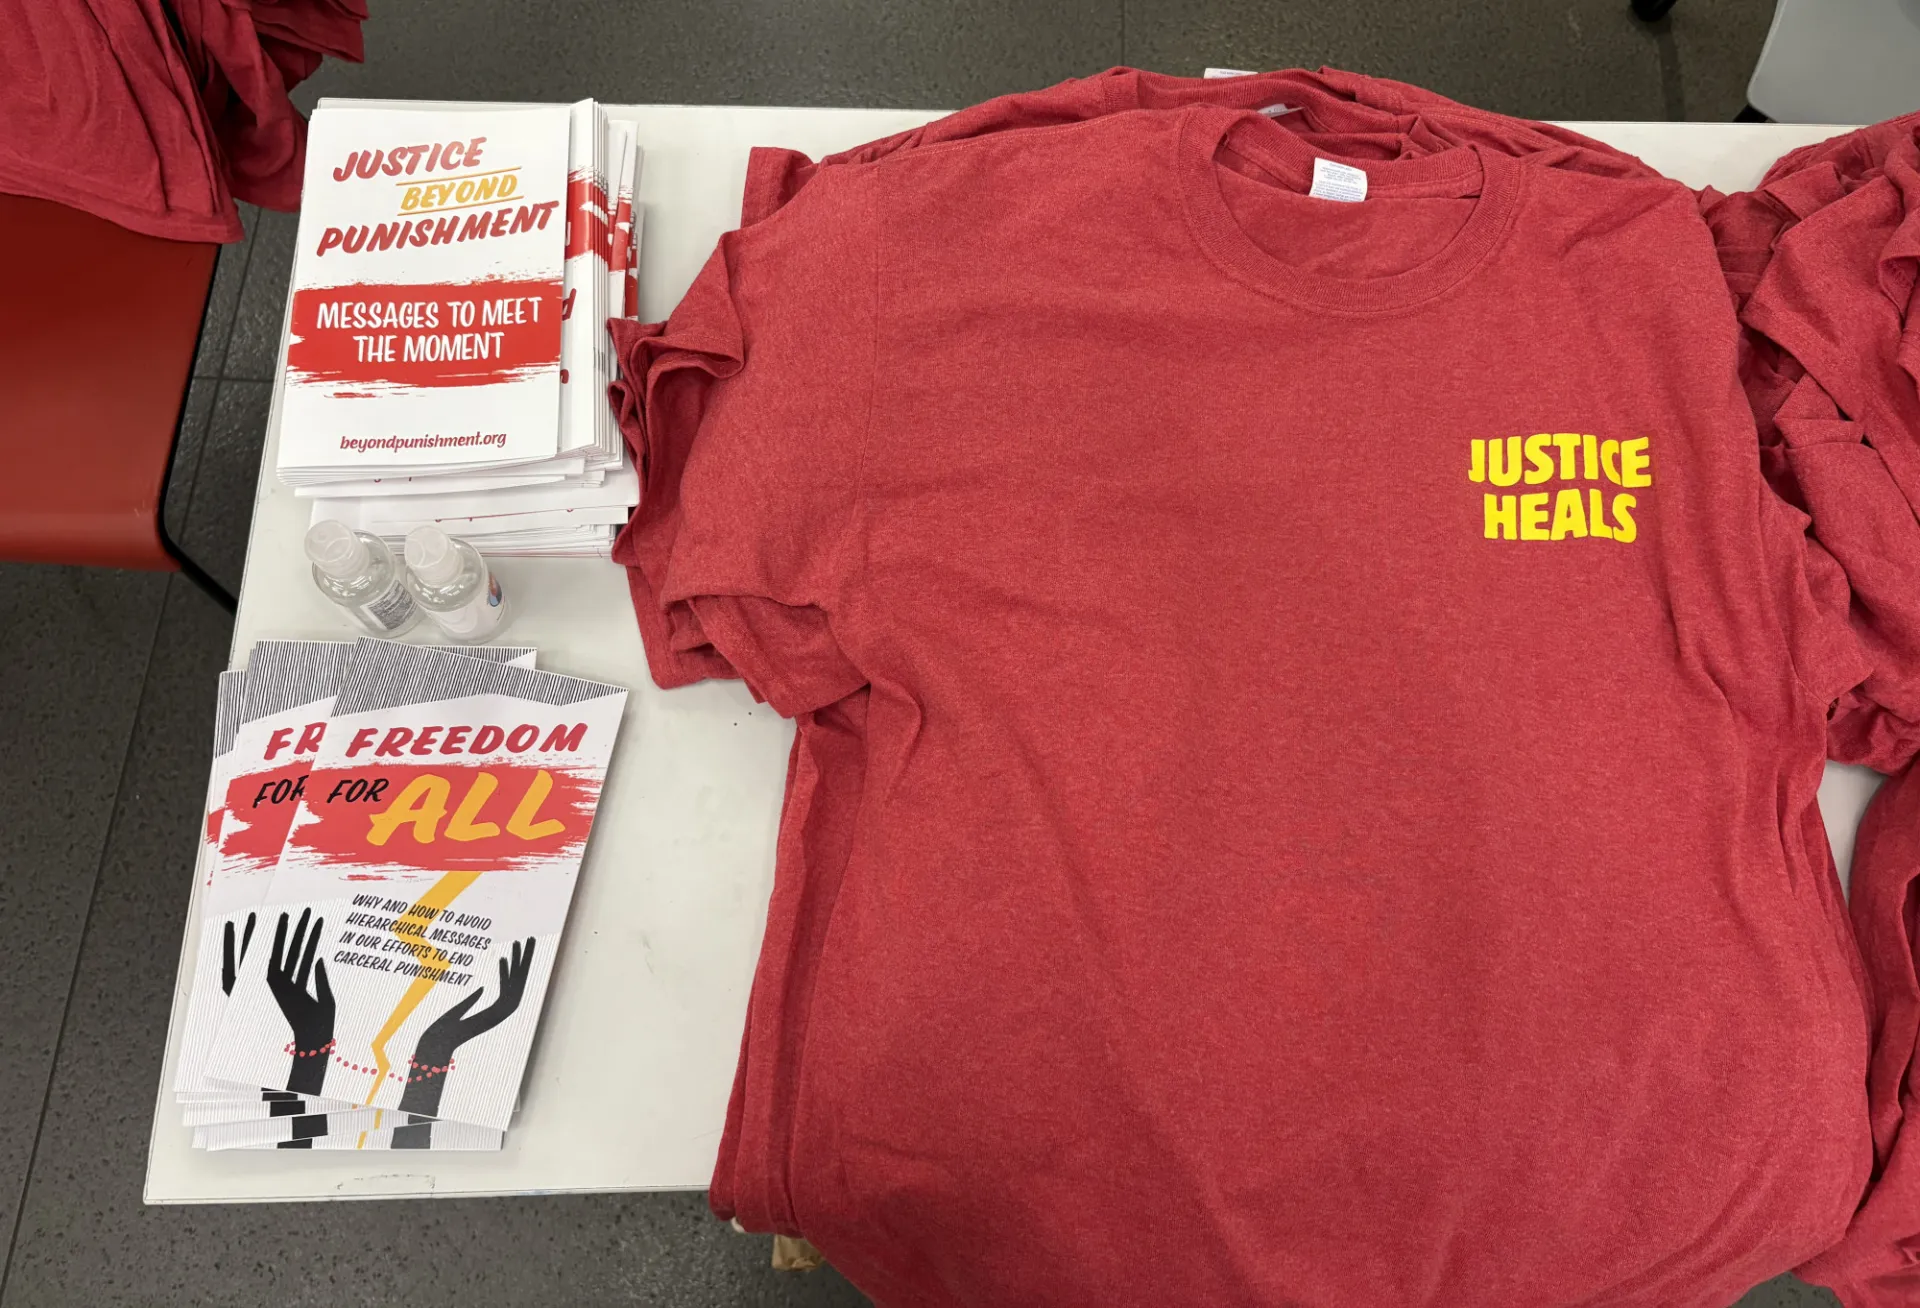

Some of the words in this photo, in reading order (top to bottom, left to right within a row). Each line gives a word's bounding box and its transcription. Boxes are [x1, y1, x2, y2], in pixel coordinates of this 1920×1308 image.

[333, 137, 487, 182] JUSTICE
[400, 174, 518, 211] BEYOND
[316, 200, 559, 257] PUNISHMENT
[316, 301, 439, 330] MESSAGES
[447, 301, 475, 327] TO
[482, 296, 543, 326] MEET
[353, 334, 396, 363] THE
[403, 332, 505, 362] MOMENT
[340, 431, 507, 453] beyondpunishment.org
[1468, 433, 1652, 488] JUSTICE
[1484, 488, 1637, 544] HEALS
[345, 722, 588, 758] FREEDOM
[327, 778, 389, 804] FOR
[366, 769, 566, 846] ALL
[352, 894, 383, 909] WHY
[382, 900, 408, 914] AND
[408, 904, 439, 920] HOW
[439, 911, 454, 923] TO
[454, 914, 492, 931] AVOID
[339, 932, 356, 944] IN
[355, 935, 384, 948] OUR
[382, 940, 432, 959] EFFORTS
[433, 949, 448, 962] TO
[448, 952, 474, 967] END
[345, 913, 428, 938] HIERARCHICAL
[429, 929, 492, 951] MESSAGES
[333, 951, 394, 972] CARCERAL
[394, 962, 473, 987] PUNISHMENT
